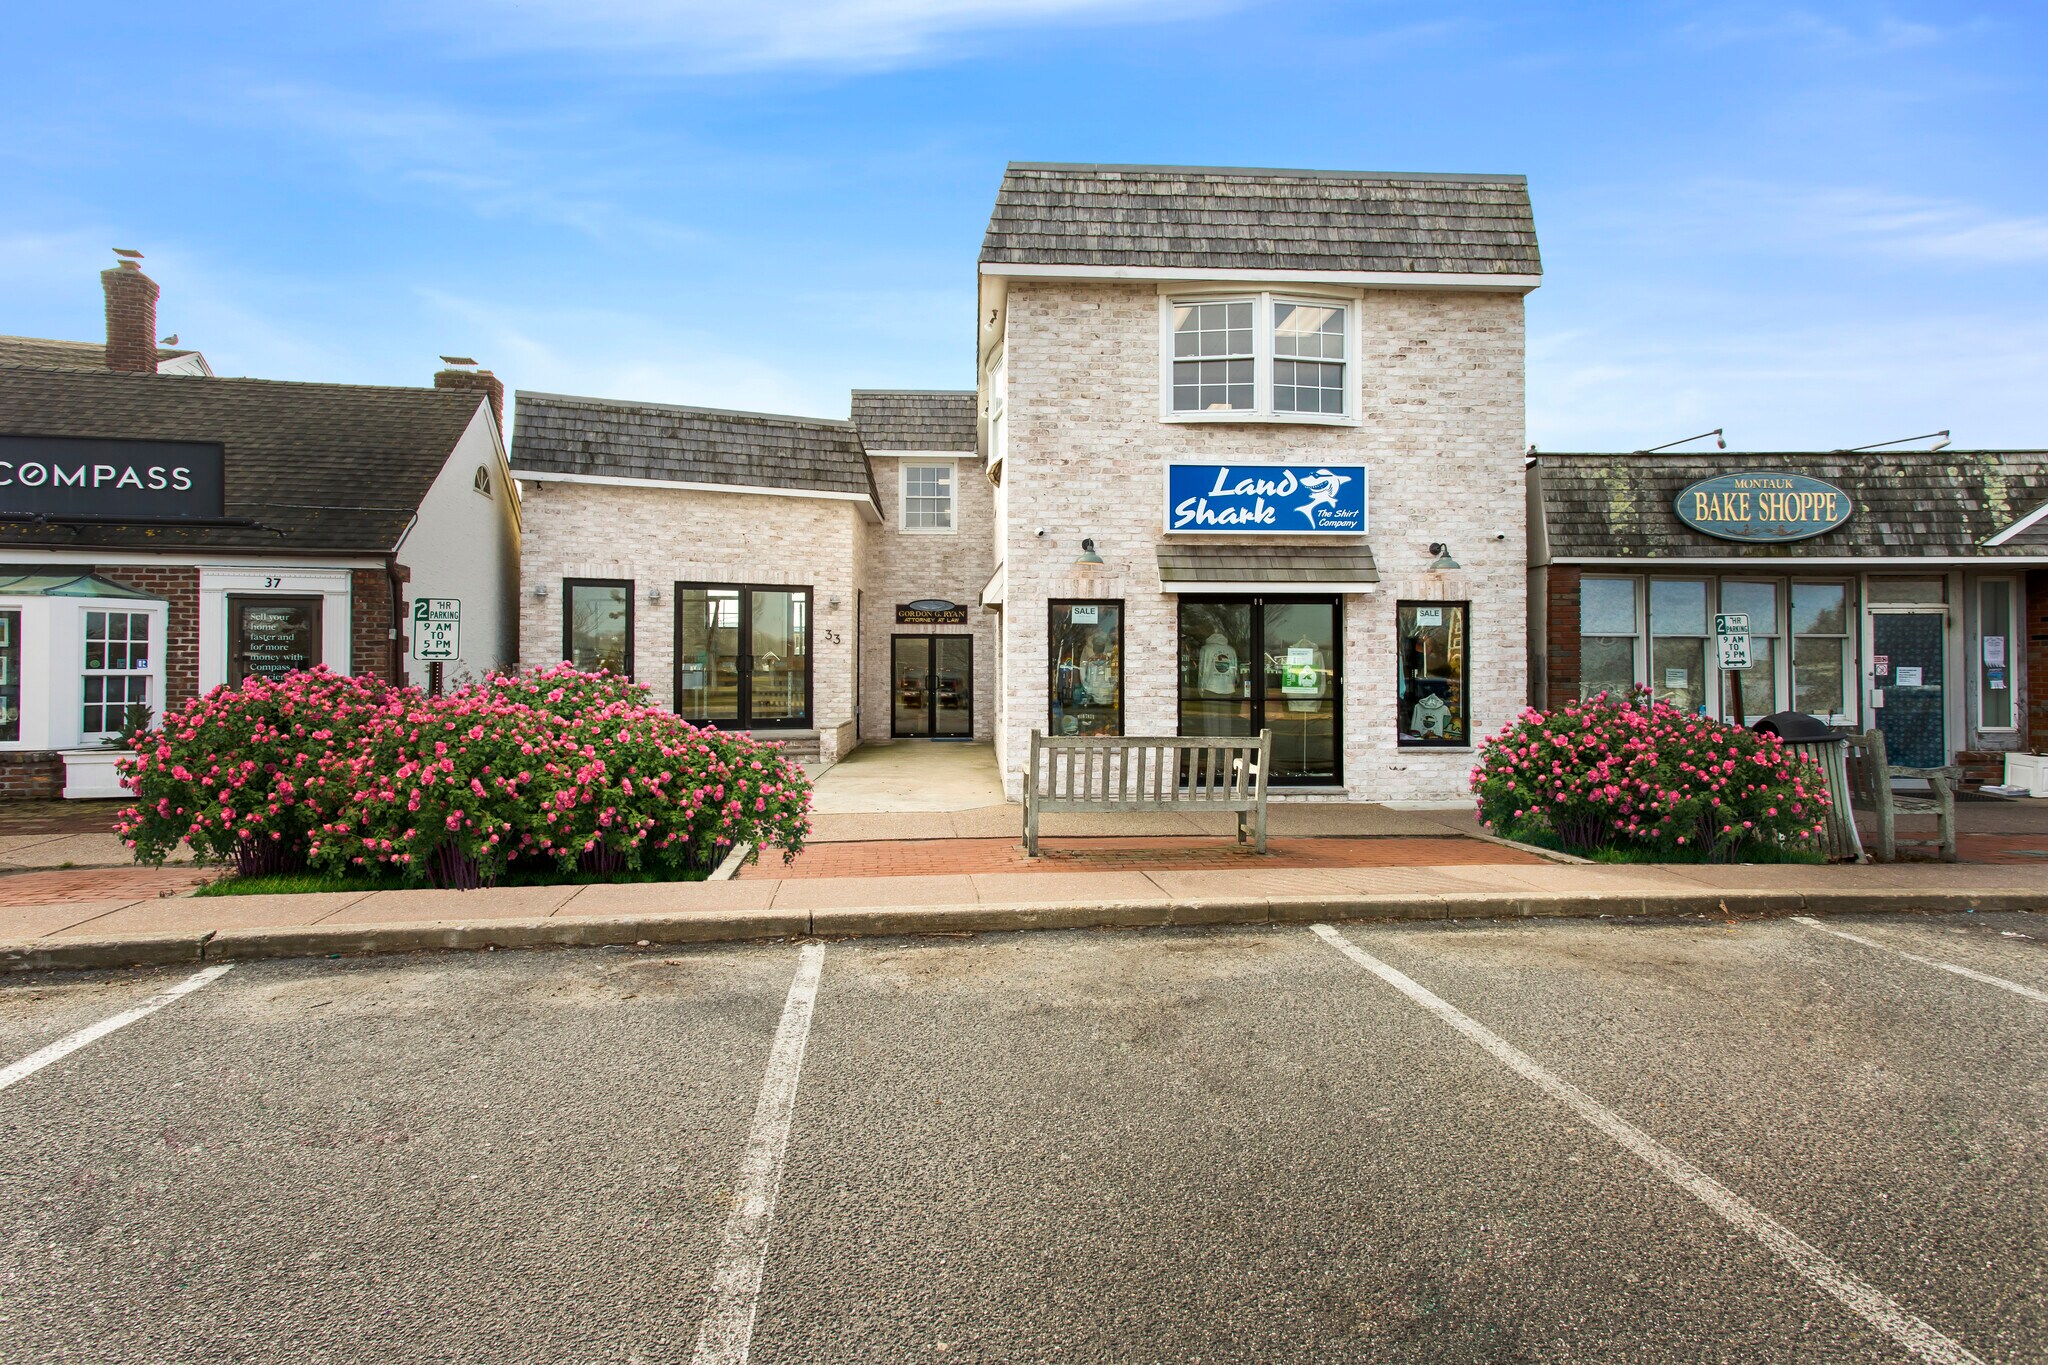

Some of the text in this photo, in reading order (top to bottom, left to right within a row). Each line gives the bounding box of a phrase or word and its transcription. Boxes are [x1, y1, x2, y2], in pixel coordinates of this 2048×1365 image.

[1208, 467, 1299, 497] Land
[1734, 479, 1794, 489] MONTAUK
[1694, 492, 1839, 522] BAKE SHOPPE
[1174, 497, 1276, 529] Shark
[1317, 509, 1359, 518] The Shirt
[1318, 518, 1358, 529] Company
[265, 577, 281, 588] 37
[415, 602, 428, 618] 2
[1074, 607, 1096, 615] SALE
[1420, 609, 1440, 617] SALE
[250, 612, 290, 622] Sell your
[430, 611, 459, 620] PARKING
[250, 622, 277, 631] home
[436, 623, 452, 631] AM
[1717, 619, 1724, 632] 2
[250, 633, 276, 641] faster
[825, 629, 841, 645] 33
[250, 643, 264, 651] for
[424, 640, 451, 648] 5 PM
[250, 653, 303, 662] money with
[250, 663, 291, 672] Compass
